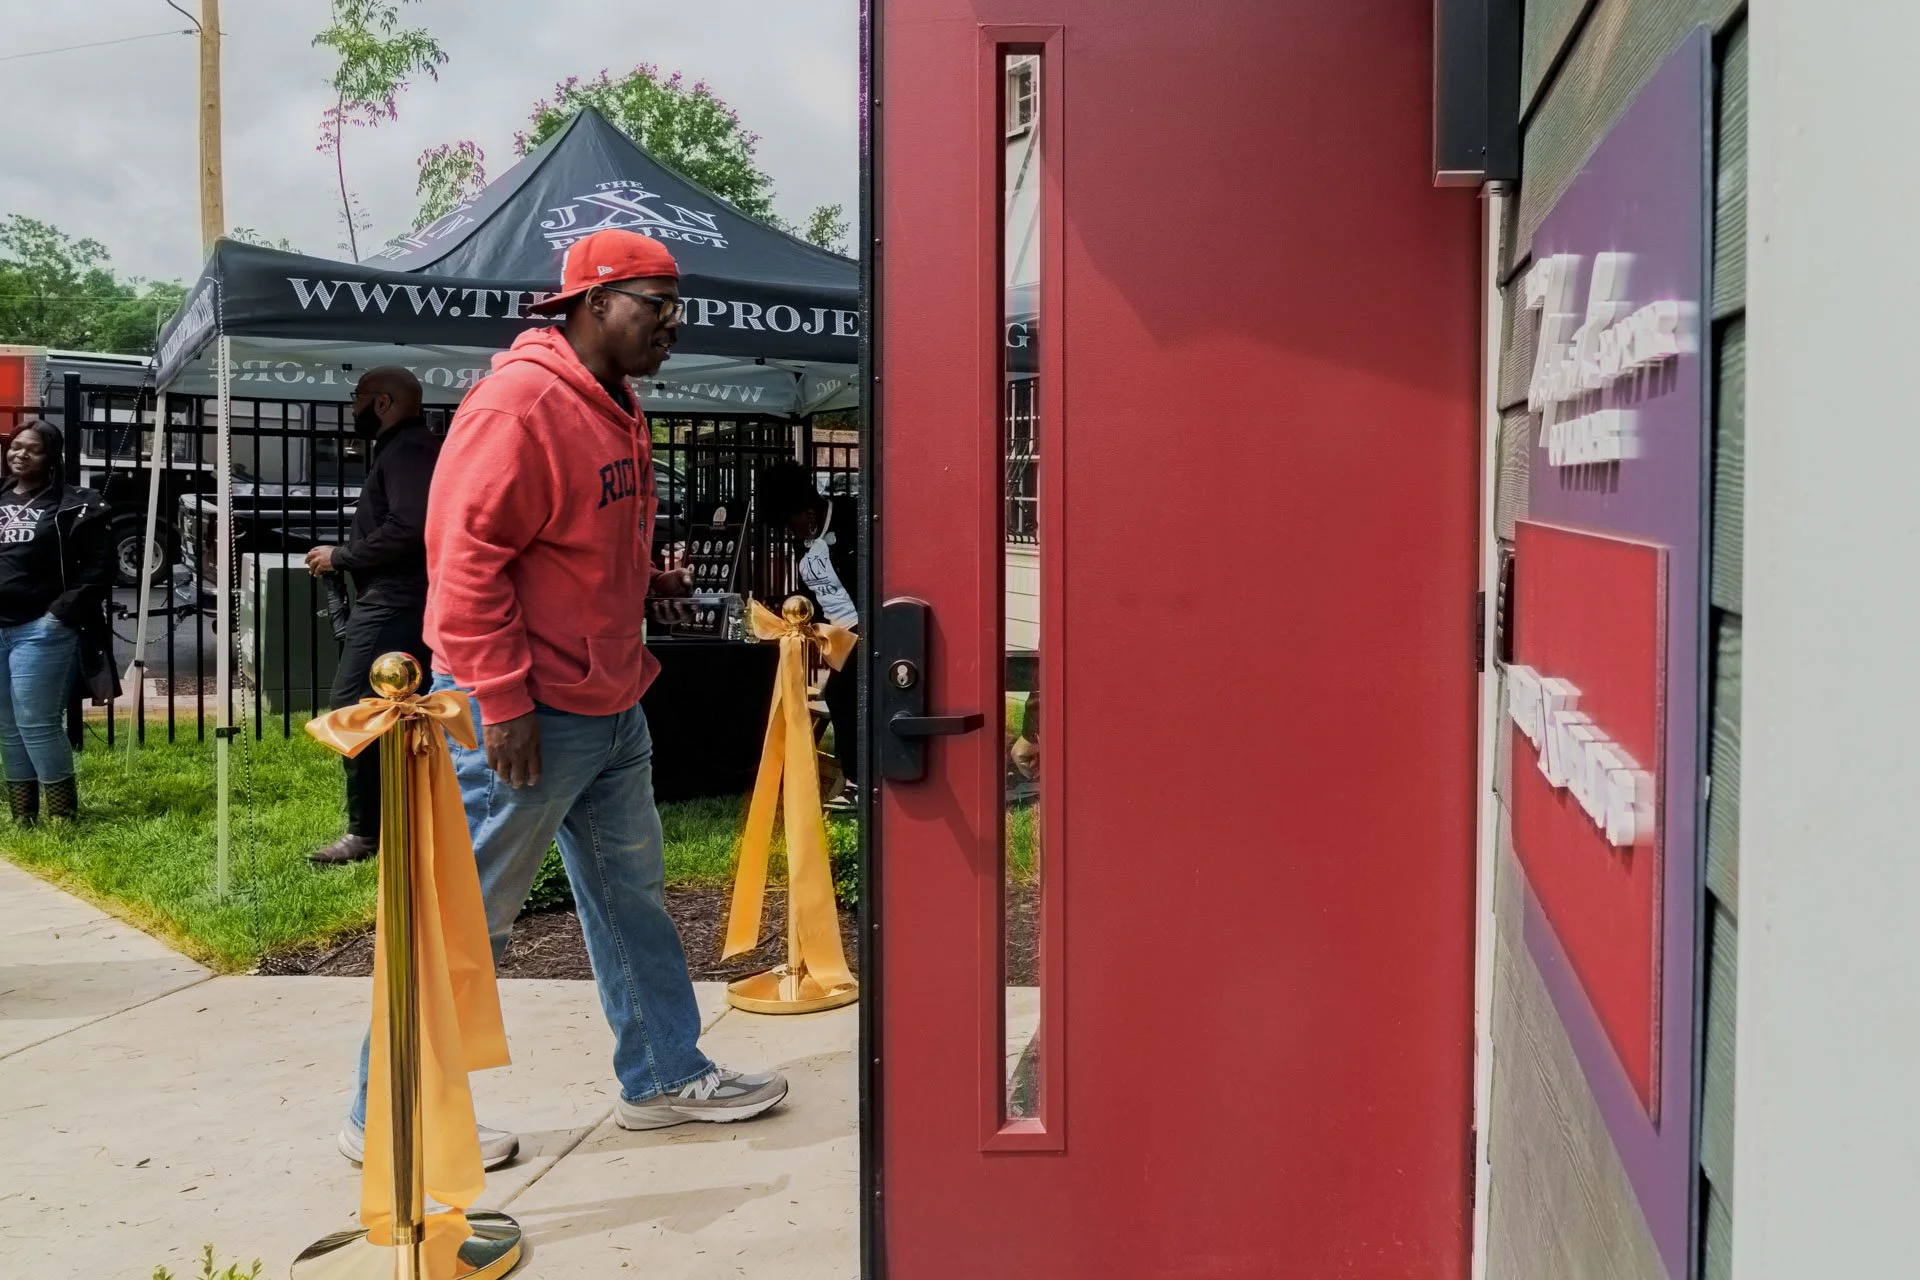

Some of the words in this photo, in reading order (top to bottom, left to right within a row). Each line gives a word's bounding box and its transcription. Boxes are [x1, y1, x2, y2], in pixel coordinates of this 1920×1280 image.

[595, 180, 644, 191] THE
[540, 189, 717, 230] JXN
[547, 226, 729, 251] PJECT
